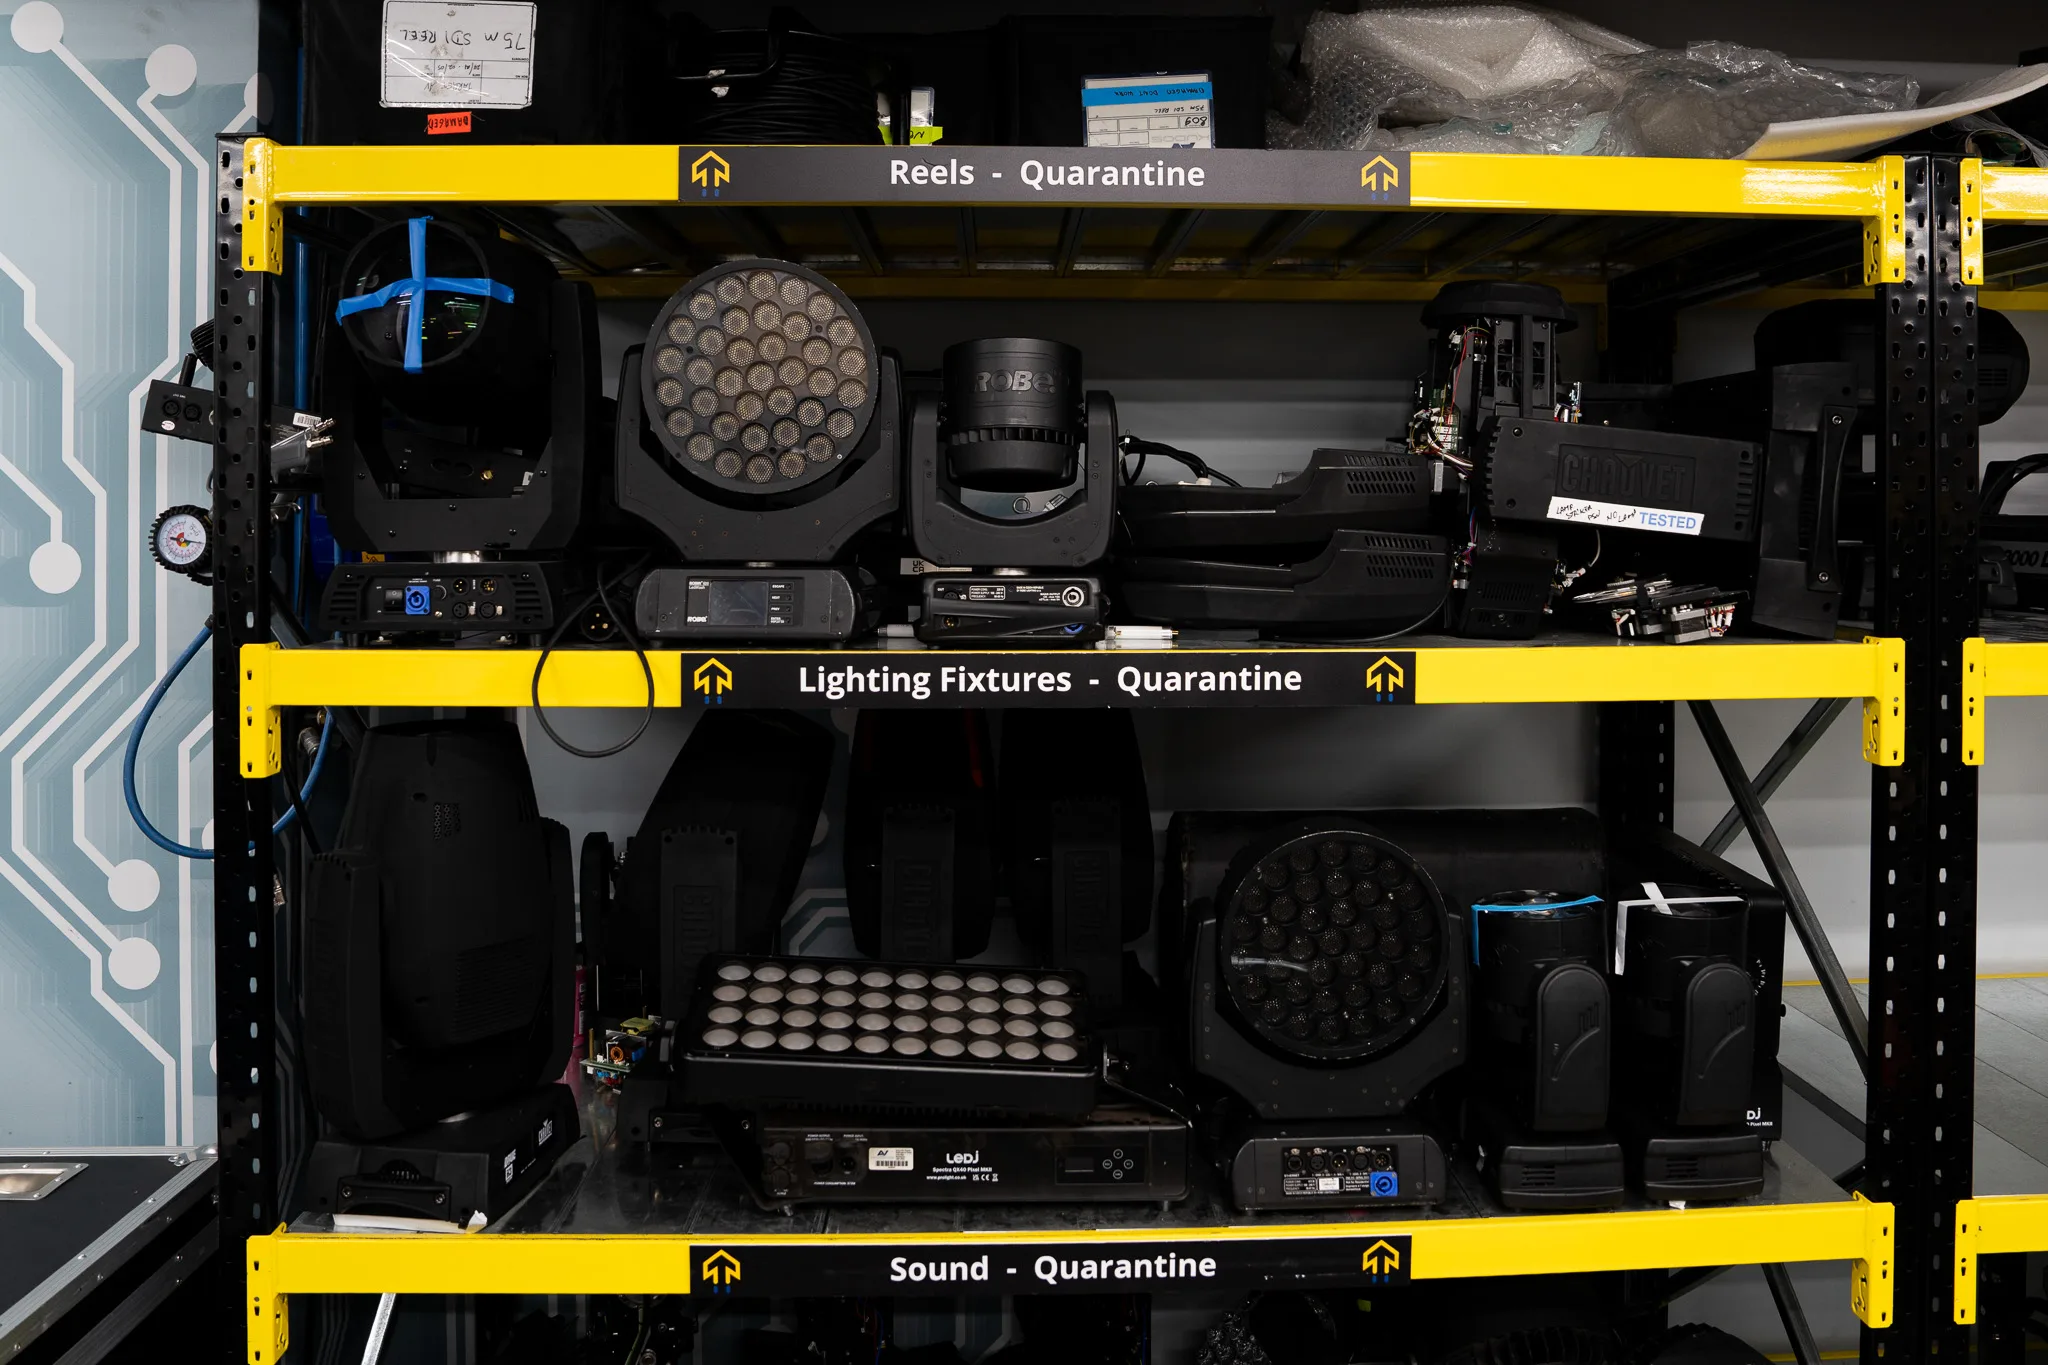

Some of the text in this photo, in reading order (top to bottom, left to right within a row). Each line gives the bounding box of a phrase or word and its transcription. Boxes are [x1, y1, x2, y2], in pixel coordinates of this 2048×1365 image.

[400, 29, 436, 43] REEL
[445, 30, 471, 45] SDI
[428, 115, 469, 130] DAMAGED
[1184, 116, 1208, 127] 809
[890, 158, 975, 185] Reels
[1020, 158, 1206, 191] Quarantine
[1560, 452, 1686, 502] CHAUVET
[1640, 511, 1697, 530] TESTED
[800, 665, 931, 700] Lighting
[941, 665, 1072, 693] Fixtures
[1117, 664, 1302, 697] Quarantine
[890, 1255, 989, 1282] Sound
[1034, 1253, 1217, 1285] Quarantine
